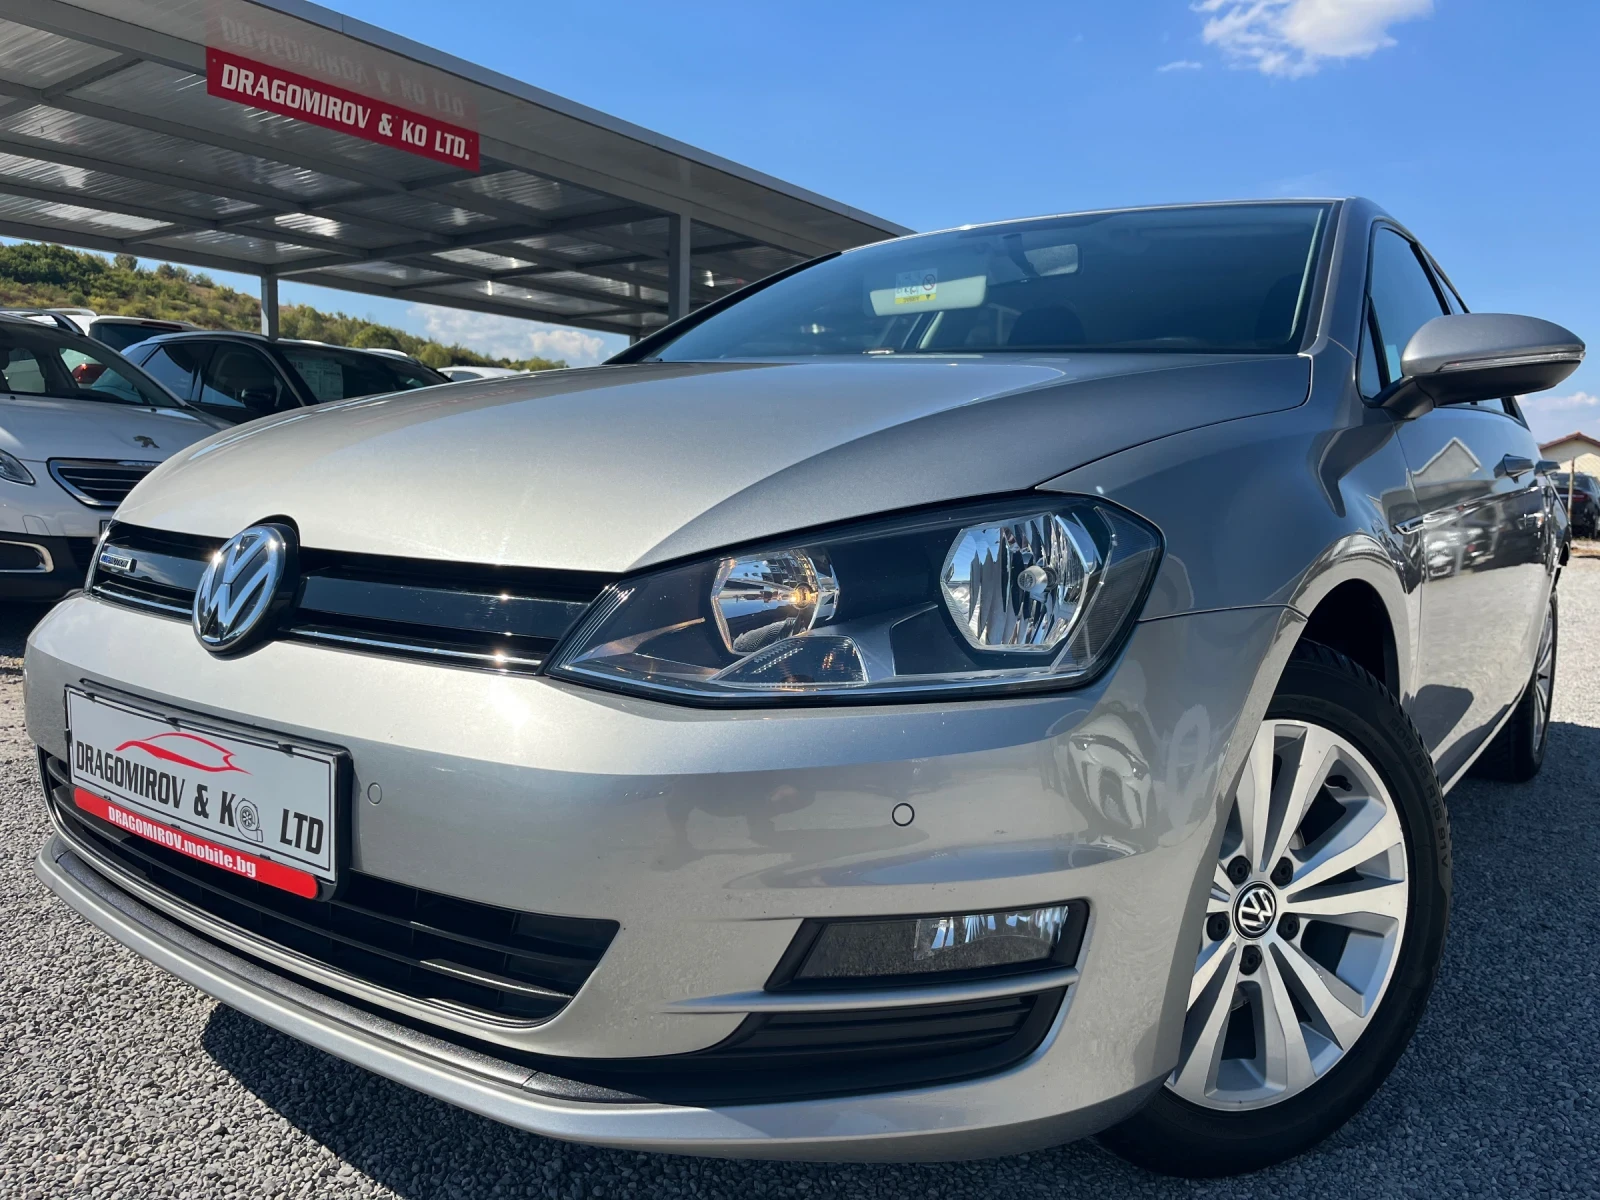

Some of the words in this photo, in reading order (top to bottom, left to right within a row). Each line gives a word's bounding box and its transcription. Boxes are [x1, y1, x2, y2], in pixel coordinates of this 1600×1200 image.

[221, 63, 371, 129] DRAGOMIROV
[378, 113, 393, 137] &
[401, 119, 428, 147] KO
[435, 130, 470, 161] LTD.
[76, 740, 185, 809] DRAGOMIROV
[193, 783, 209, 819] &
[280, 808, 324, 855] LTD
[1388, 717, 1430, 779] 205/55
[1426, 784, 1443, 821] R16
[108, 805, 257, 878] DRAGOMIROV.mobile.bg
